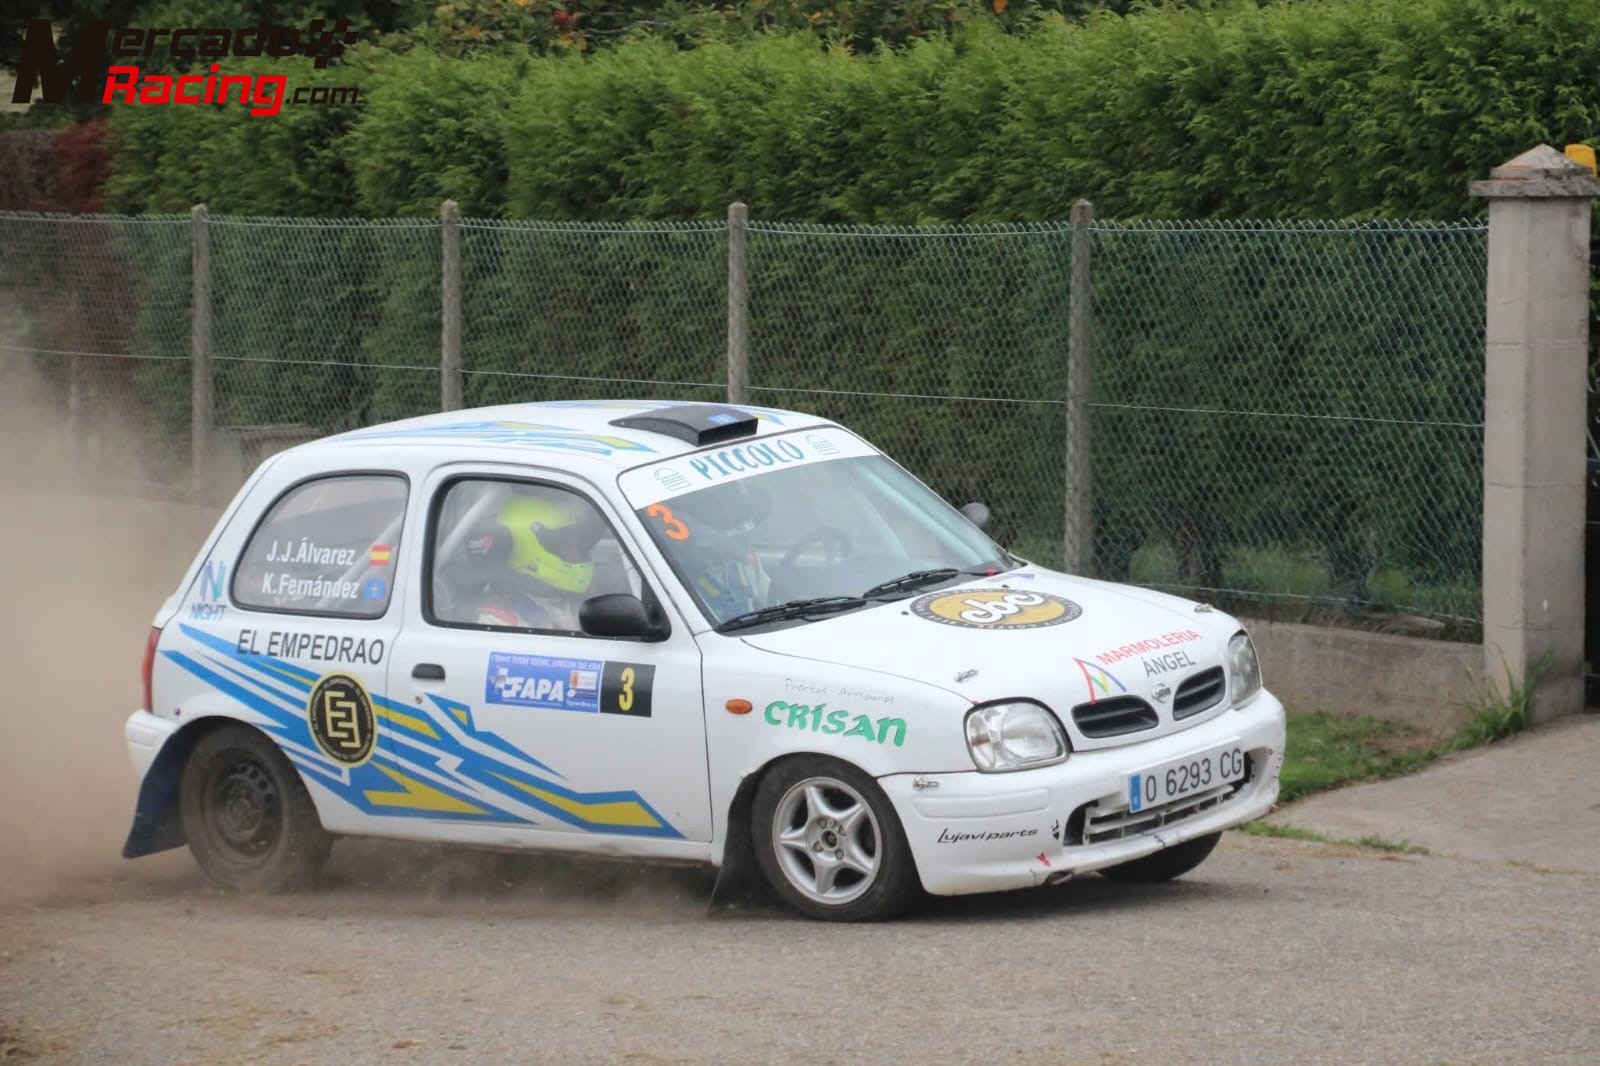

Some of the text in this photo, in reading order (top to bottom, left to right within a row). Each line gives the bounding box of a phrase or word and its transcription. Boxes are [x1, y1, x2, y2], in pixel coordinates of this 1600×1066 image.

[690, 439, 804, 480] PICCOLO
[647, 502, 690, 541] 3
[237, 629, 384, 665] EL EMPEDRAO
[618, 667, 635, 711] 3
[1166, 758, 1212, 796] 6293
[1220, 748, 1242, 779] CG
